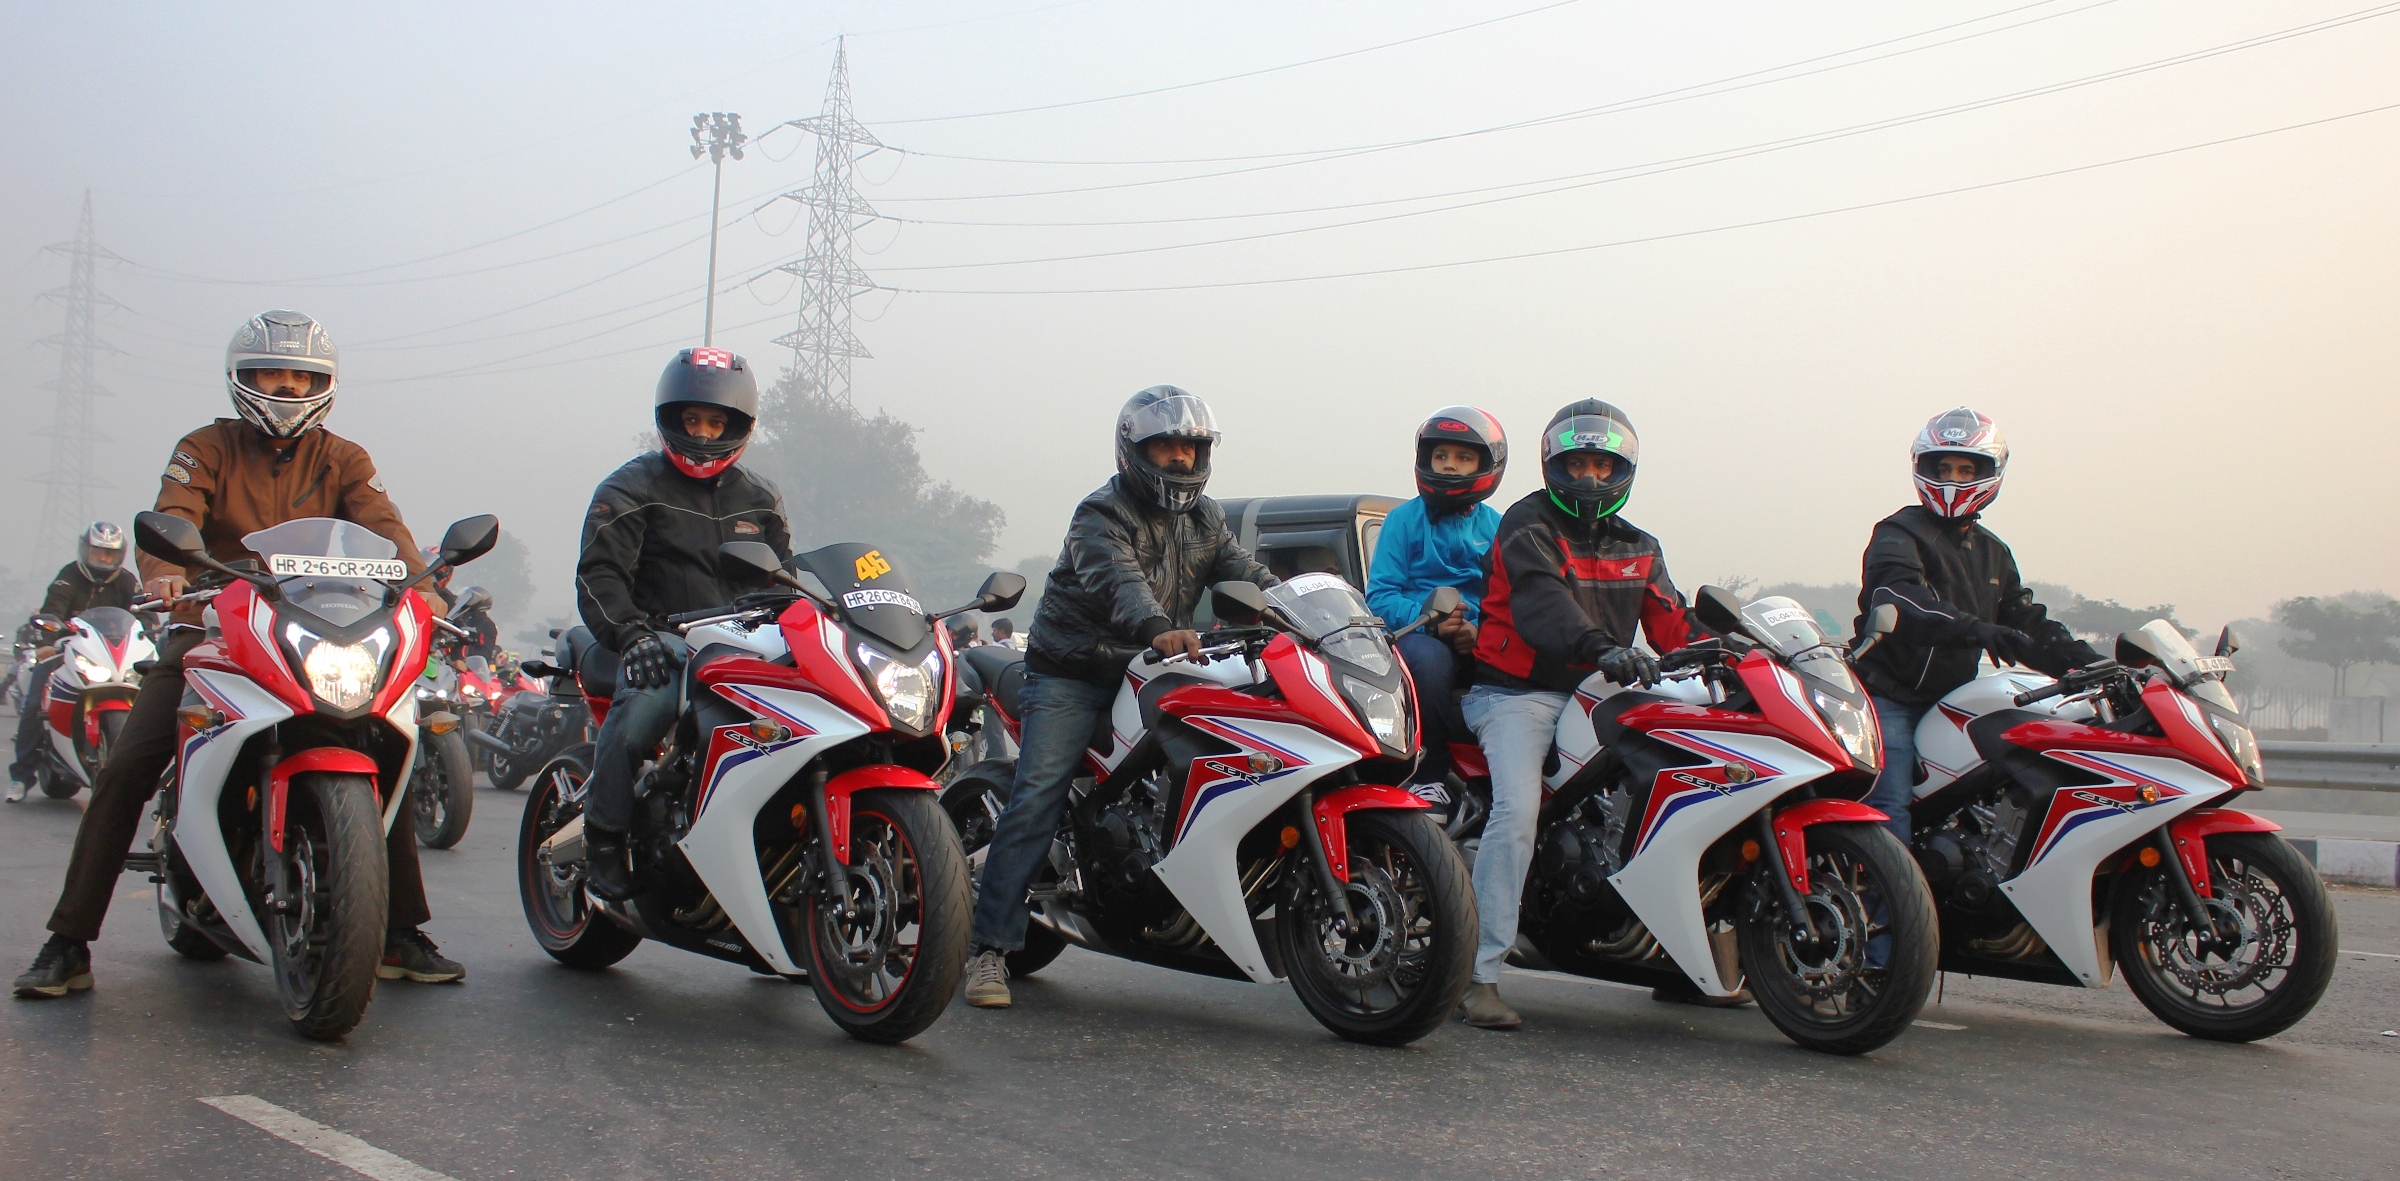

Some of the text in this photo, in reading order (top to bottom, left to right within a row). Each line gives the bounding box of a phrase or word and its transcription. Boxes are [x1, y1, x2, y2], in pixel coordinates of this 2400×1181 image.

[1576, 433, 1606, 441] HJC
[276, 558, 297, 573] HR
[854, 549, 892, 581] 46
[320, 602, 359, 611] HONDA
[845, 592, 868, 607] HR
[866, 591, 882, 603] 26
[882, 591, 901, 604] CR
[715, 623, 748, 640] HONDA
[724, 729, 772, 757] CBR
[1205, 760, 1262, 787] CBR
[1671, 772, 1733, 797] CBR
[2071, 790, 2136, 815] CBR
